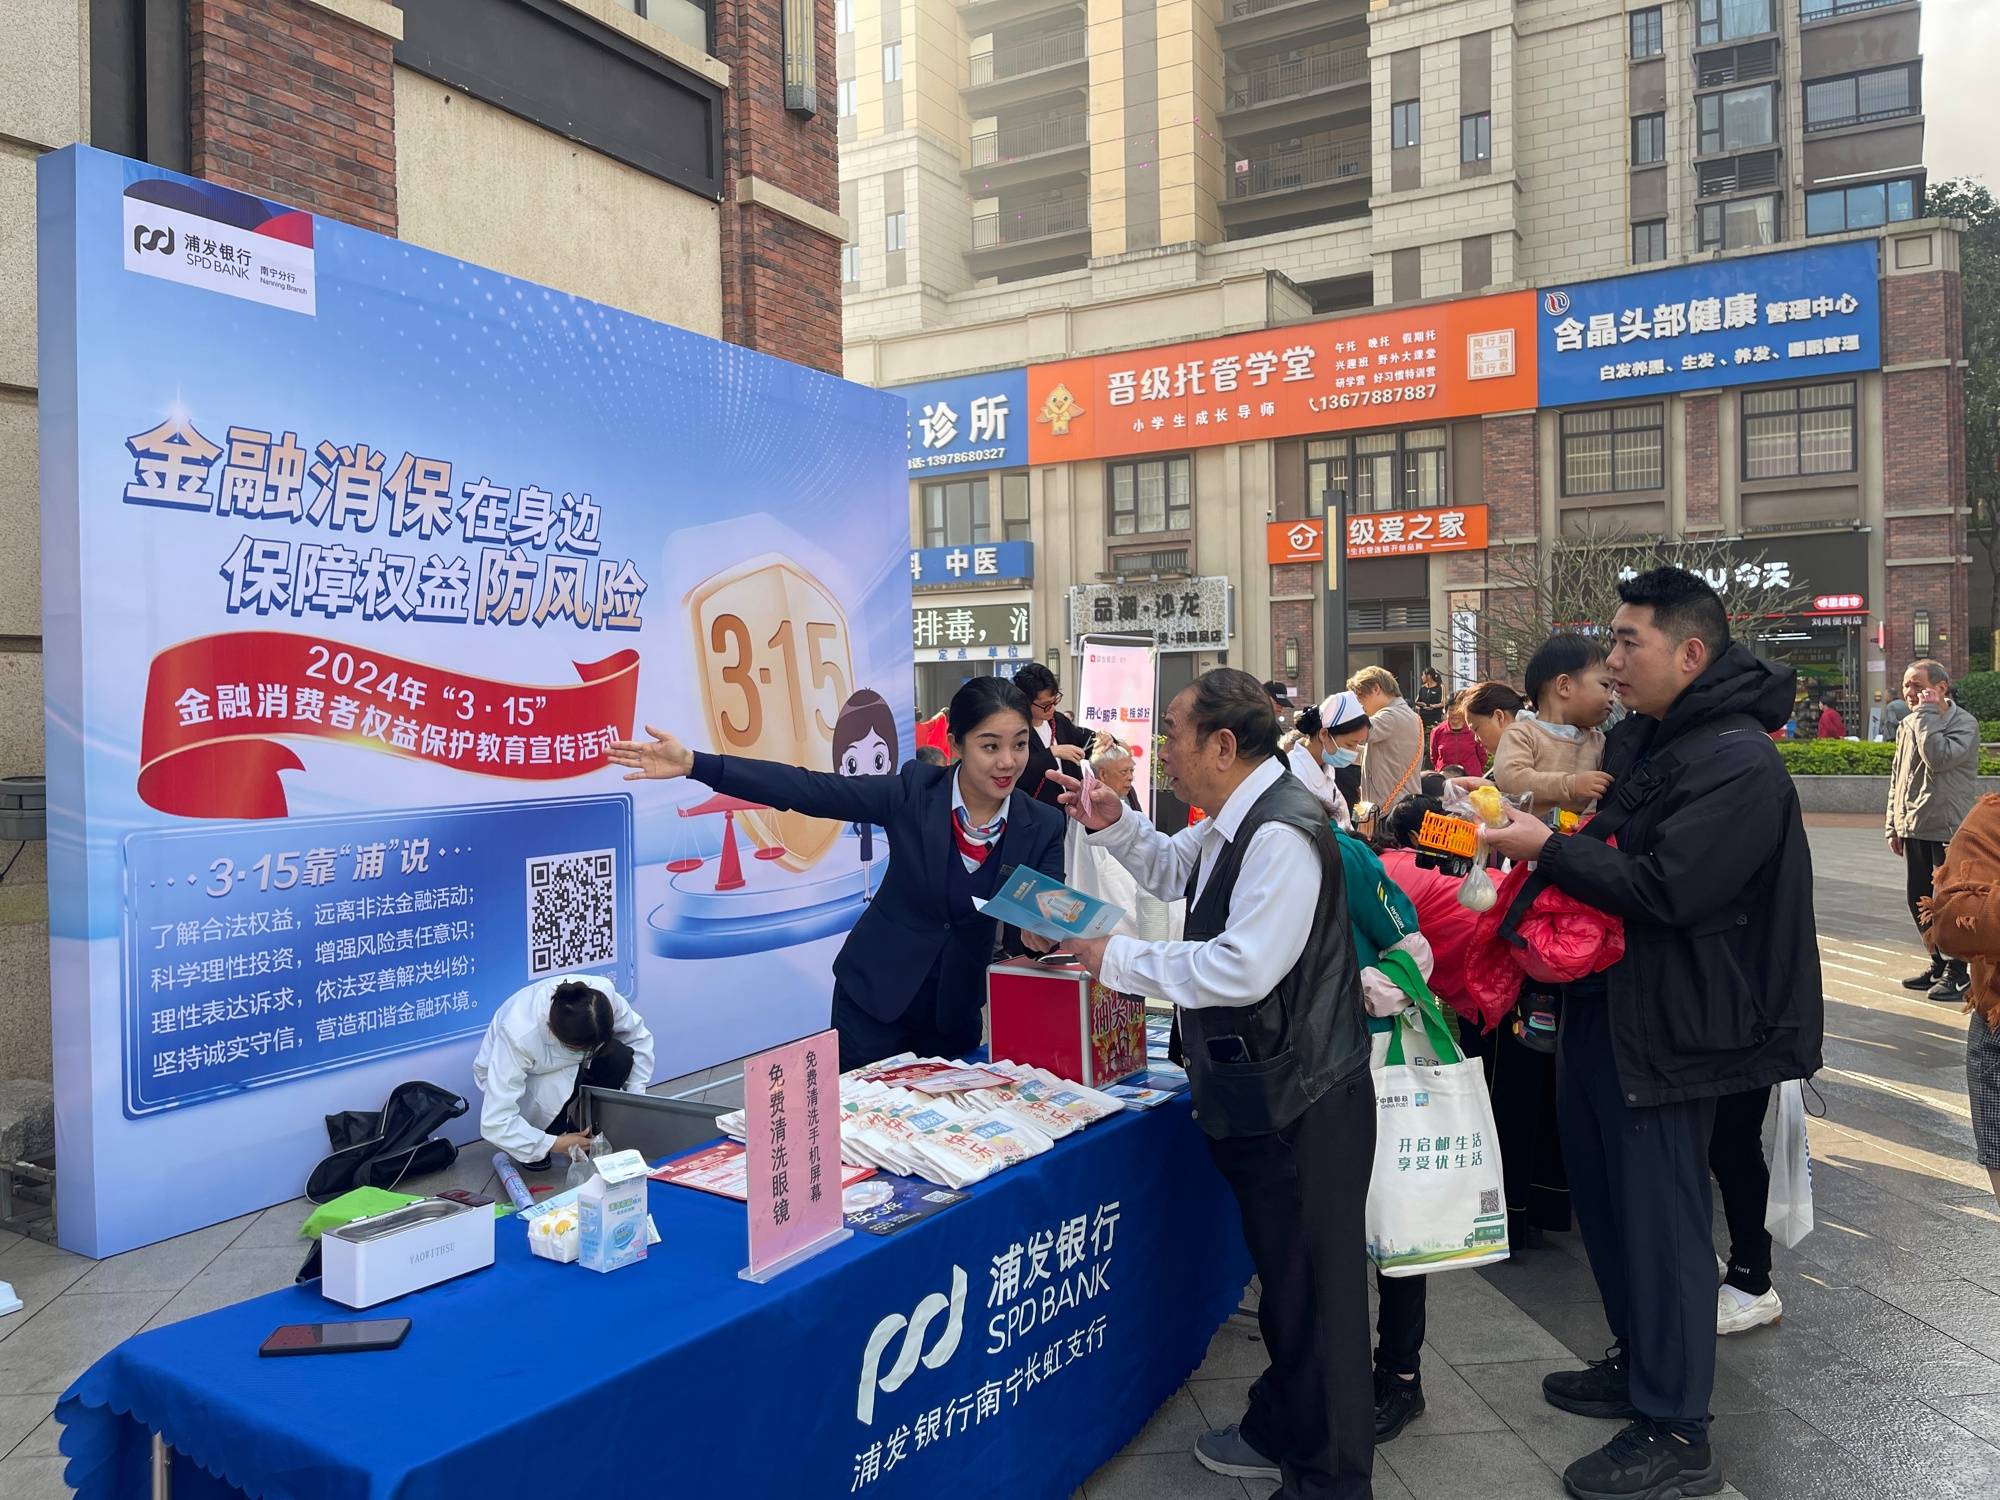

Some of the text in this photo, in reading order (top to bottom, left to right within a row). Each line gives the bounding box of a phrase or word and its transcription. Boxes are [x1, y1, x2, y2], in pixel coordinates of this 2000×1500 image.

[184, 232, 252, 267] 浦发银行
[186, 253, 250, 280] SPD BANK
[260, 265, 295, 284] 南宁分行
[260, 277, 308, 295] Nanning Branch
[1553, 292, 1859, 352] 含晶头部健康 管理中心
[1335, 329, 1437, 354] 午托 晚托 假期托
[1107, 344, 1316, 406] 晋级托管学堂
[1335, 347, 1437, 372] 兴趣班 野外大课堂
[1335, 366, 1436, 389] 研学营 好习惯特训营
[1319, 384, 1437, 411] 13677887887
[907, 393, 1009, 449] 诊所
[1133, 401, 1276, 433] 小学生成长导师
[1347, 511, 1466, 545] 级爱之家
[946, 547, 998, 577] 中医
[220, 535, 648, 631] 保障权益防风险
[174, 684, 620, 766] 金融消费者权益保护教育宣传活动
[805, 1050, 822, 1203] 免费清洗手机屏幕
[1398, 1132, 1482, 1154] 开启邮生活
[768, 1063, 790, 1226] 免费清洗眼镜
[1398, 1150, 1483, 1172] 享受优生活
[987, 1201, 1121, 1309] 浦发银行
[987, 1257, 1113, 1355] SPD BANK
[850, 1314, 1107, 1493] 浦发银行南宁长虹支行
